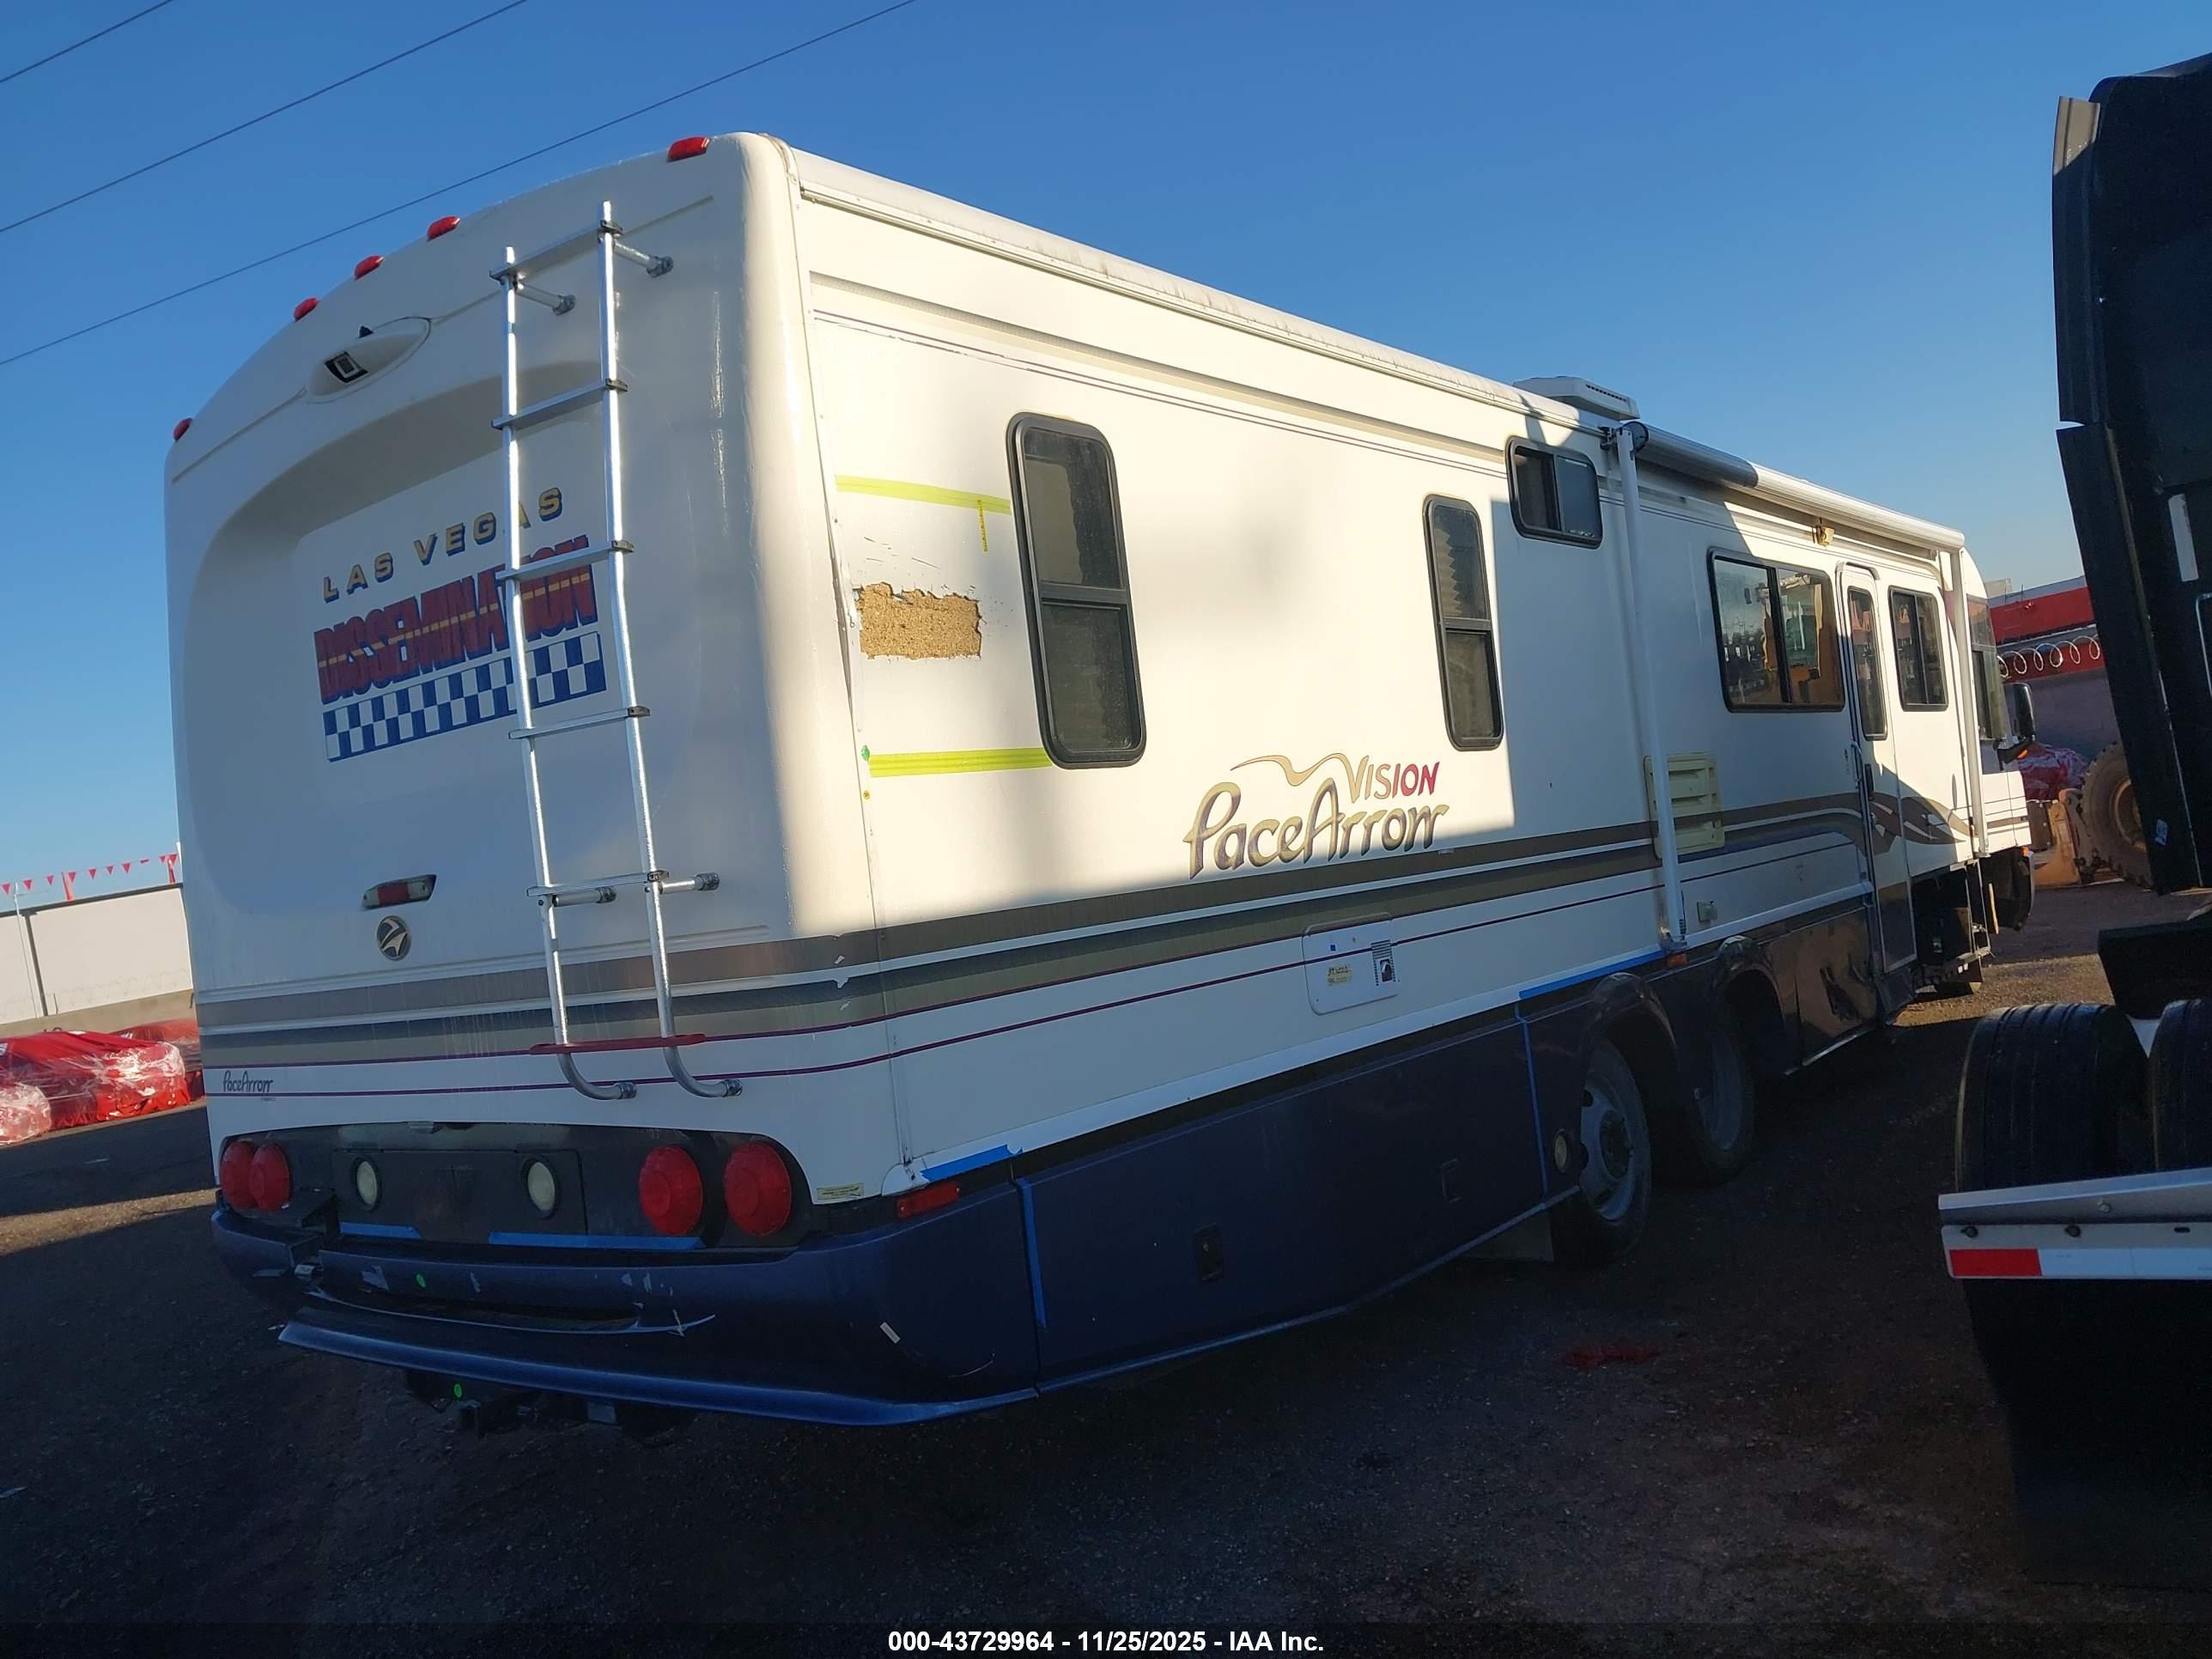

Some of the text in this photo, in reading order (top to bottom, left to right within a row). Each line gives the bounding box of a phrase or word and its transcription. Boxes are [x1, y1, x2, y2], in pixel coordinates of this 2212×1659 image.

[322, 552, 393, 603] LAS
[313, 533, 599, 706] DISSEMINAION
[1340, 755, 1440, 804] VISION
